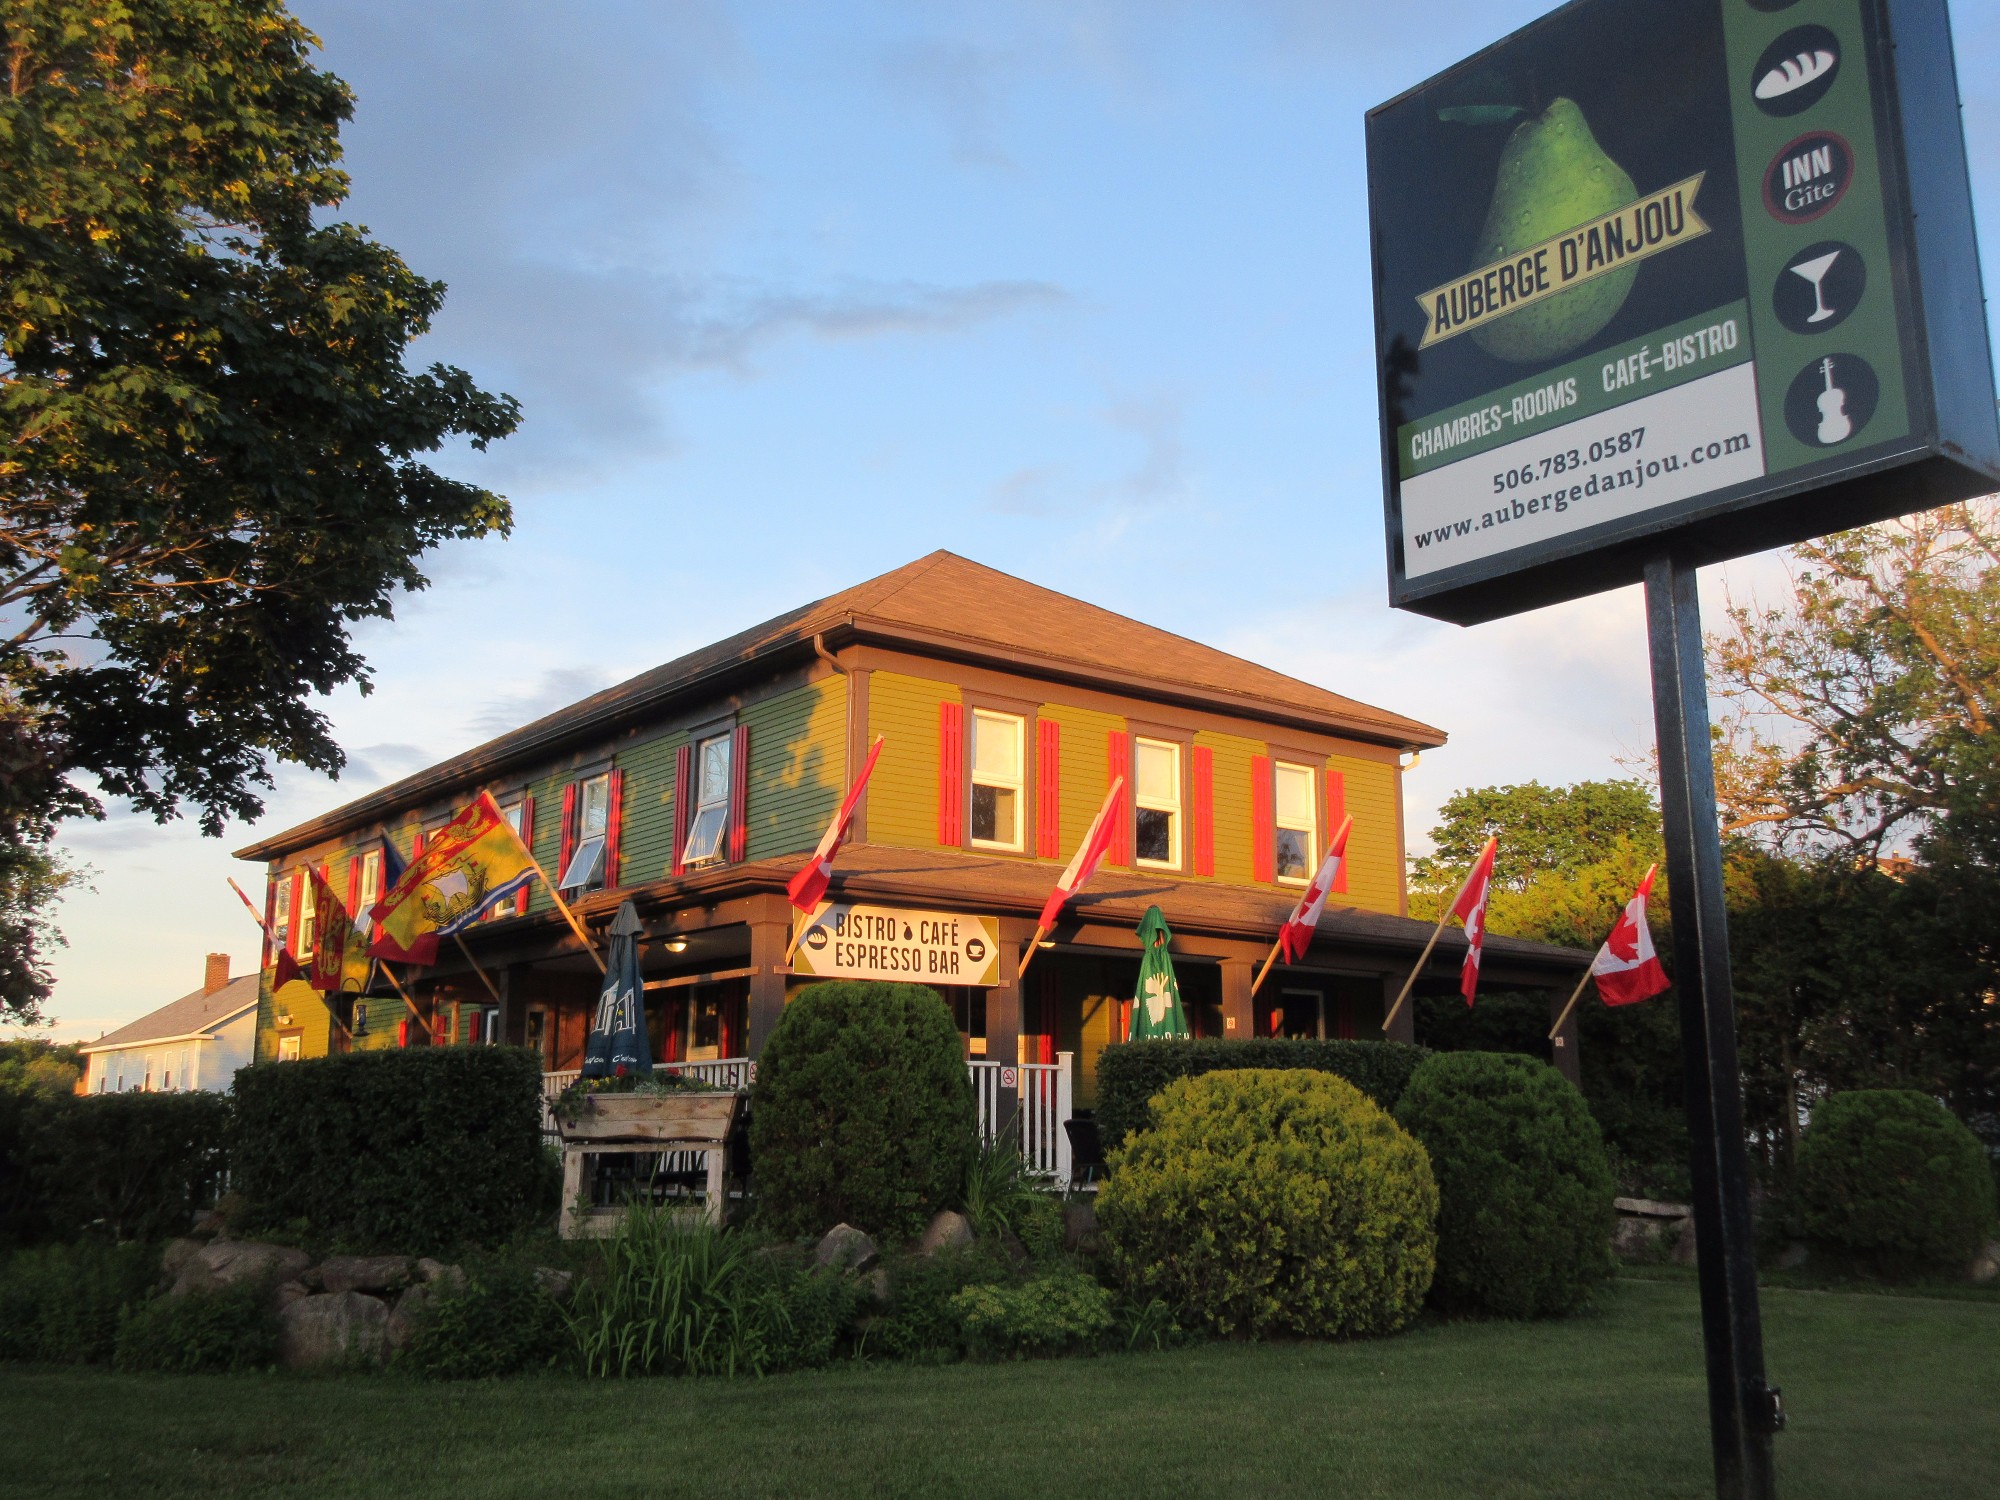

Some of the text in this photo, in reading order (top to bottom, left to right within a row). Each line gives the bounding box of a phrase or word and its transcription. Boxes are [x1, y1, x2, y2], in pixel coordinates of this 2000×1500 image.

[1782, 144, 1832, 190] INN
[1784, 182, 1836, 211] Gîte
[1433, 191, 1686, 335] AUBERGE D'ANJOU
[1411, 319, 1738, 461] CHAMBRES-ROOMS CAFÉ-BISTRO
[1493, 427, 1646, 494] 506.783.0587
[1414, 432, 1751, 549] www.aubergedanjou.com
[835, 912, 959, 947] BISTRO CAFÉ
[835, 942, 959, 975] ESPRESSO BAR
